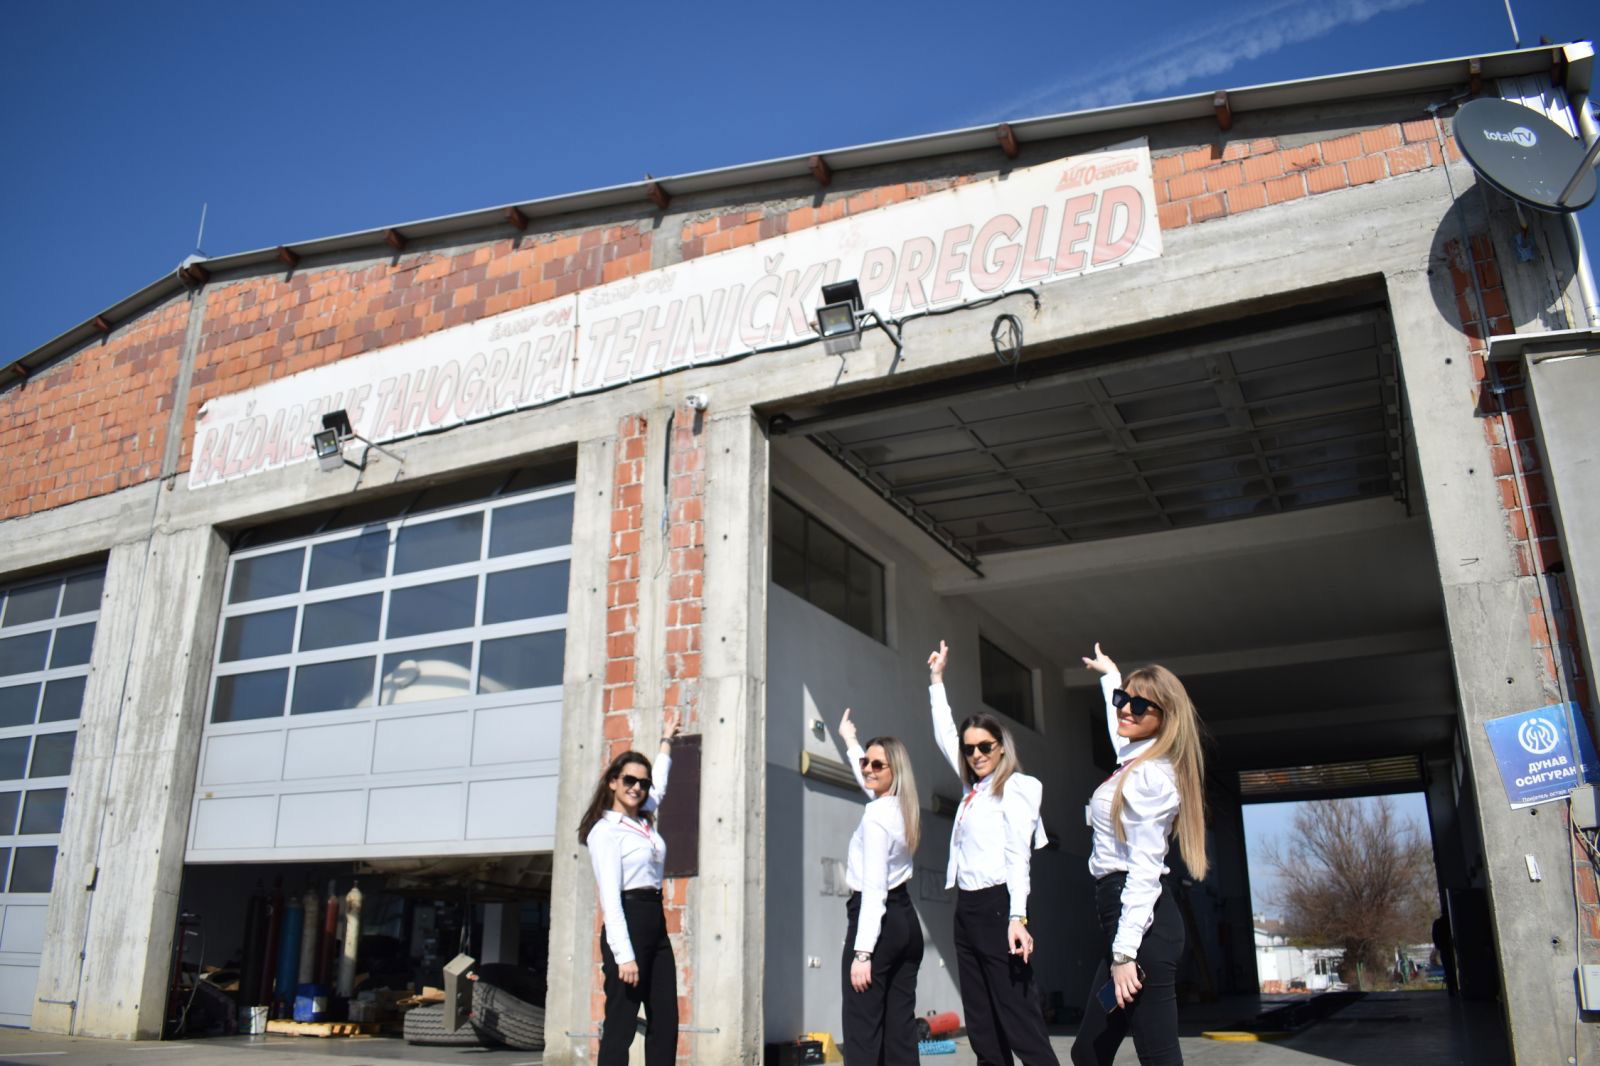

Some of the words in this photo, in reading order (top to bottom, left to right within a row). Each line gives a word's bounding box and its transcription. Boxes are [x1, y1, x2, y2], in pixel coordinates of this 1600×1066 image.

[858, 185, 1146, 320] PREGLED
[370, 330, 574, 438] TAHOGRAFA
[1528, 755, 1568, 775] ДУНАВ
